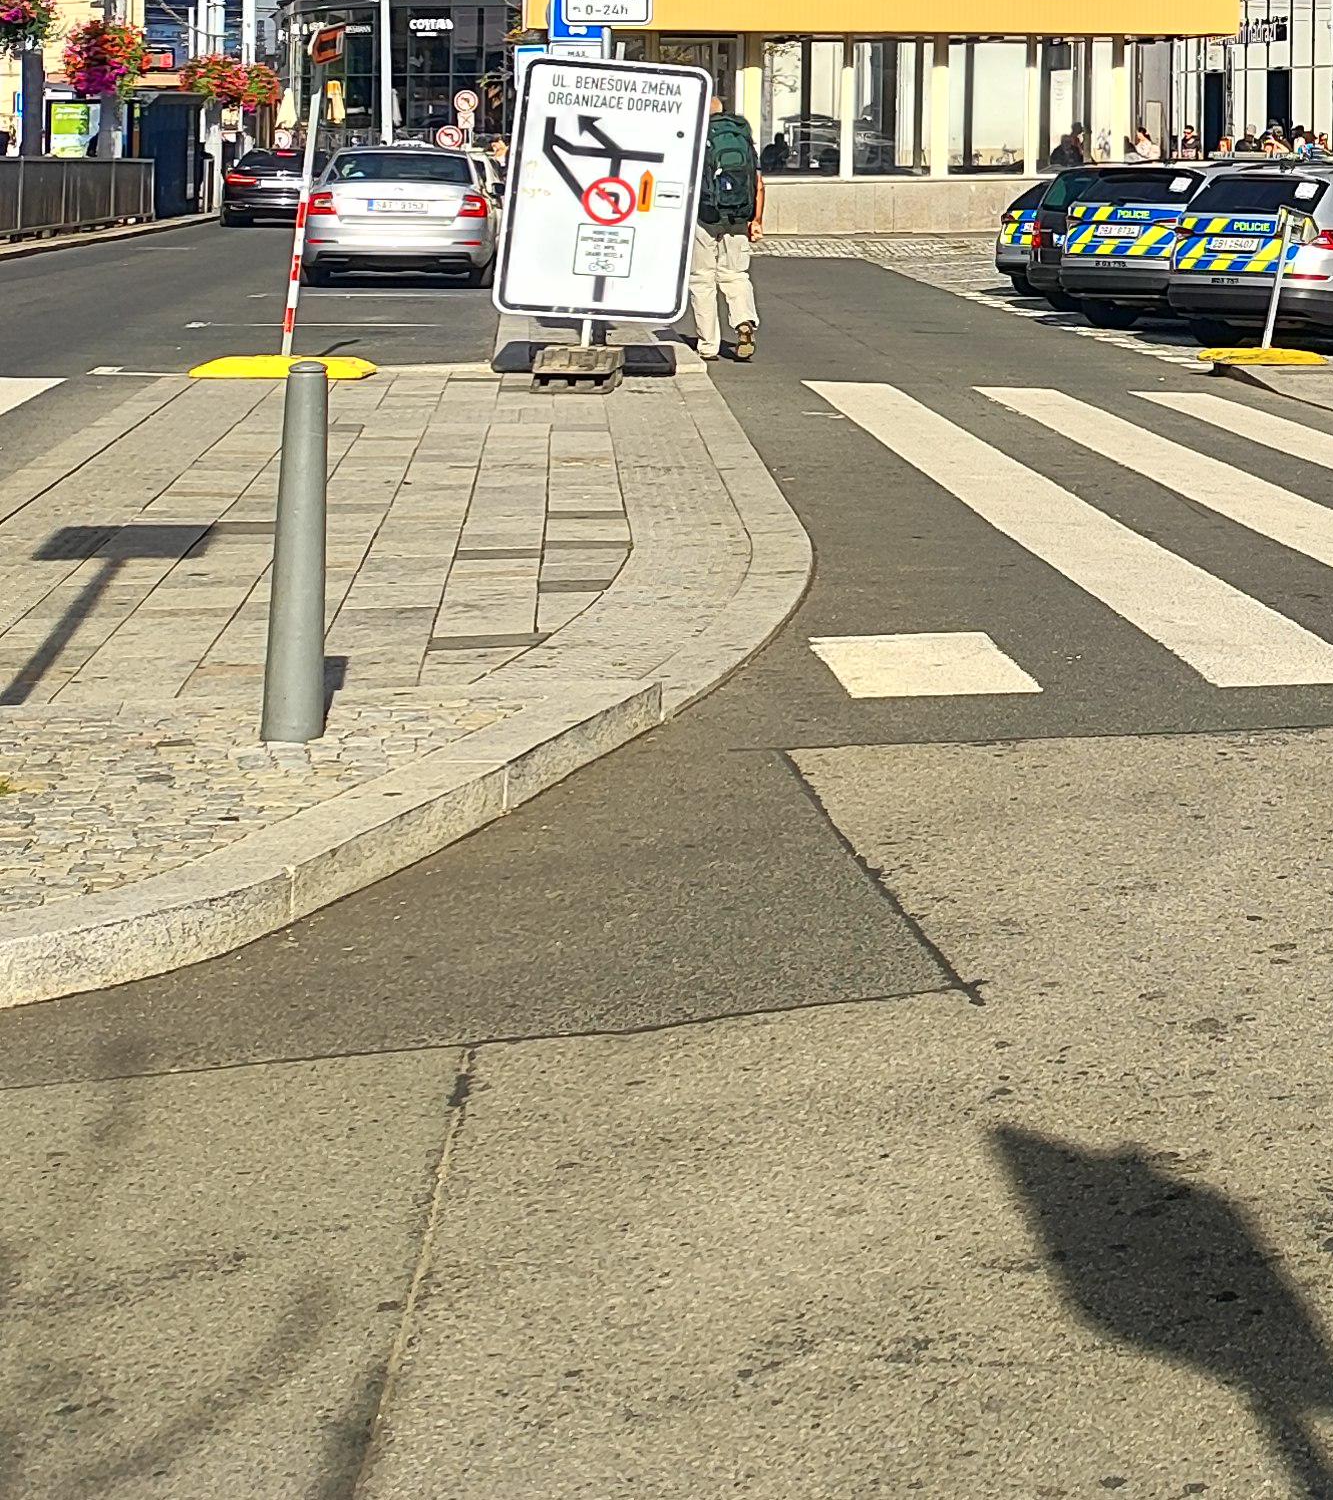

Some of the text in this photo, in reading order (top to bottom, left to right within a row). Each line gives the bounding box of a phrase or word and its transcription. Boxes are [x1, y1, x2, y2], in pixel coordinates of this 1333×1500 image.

[552, 73, 682, 96] UL. BENEŠOVA ZMĚNA
[548, 91, 683, 114] ORGANIZACE DOPRAVY
[1116, 209, 1151, 219] POLICIE
[1233, 221, 1271, 232] POLICIE
